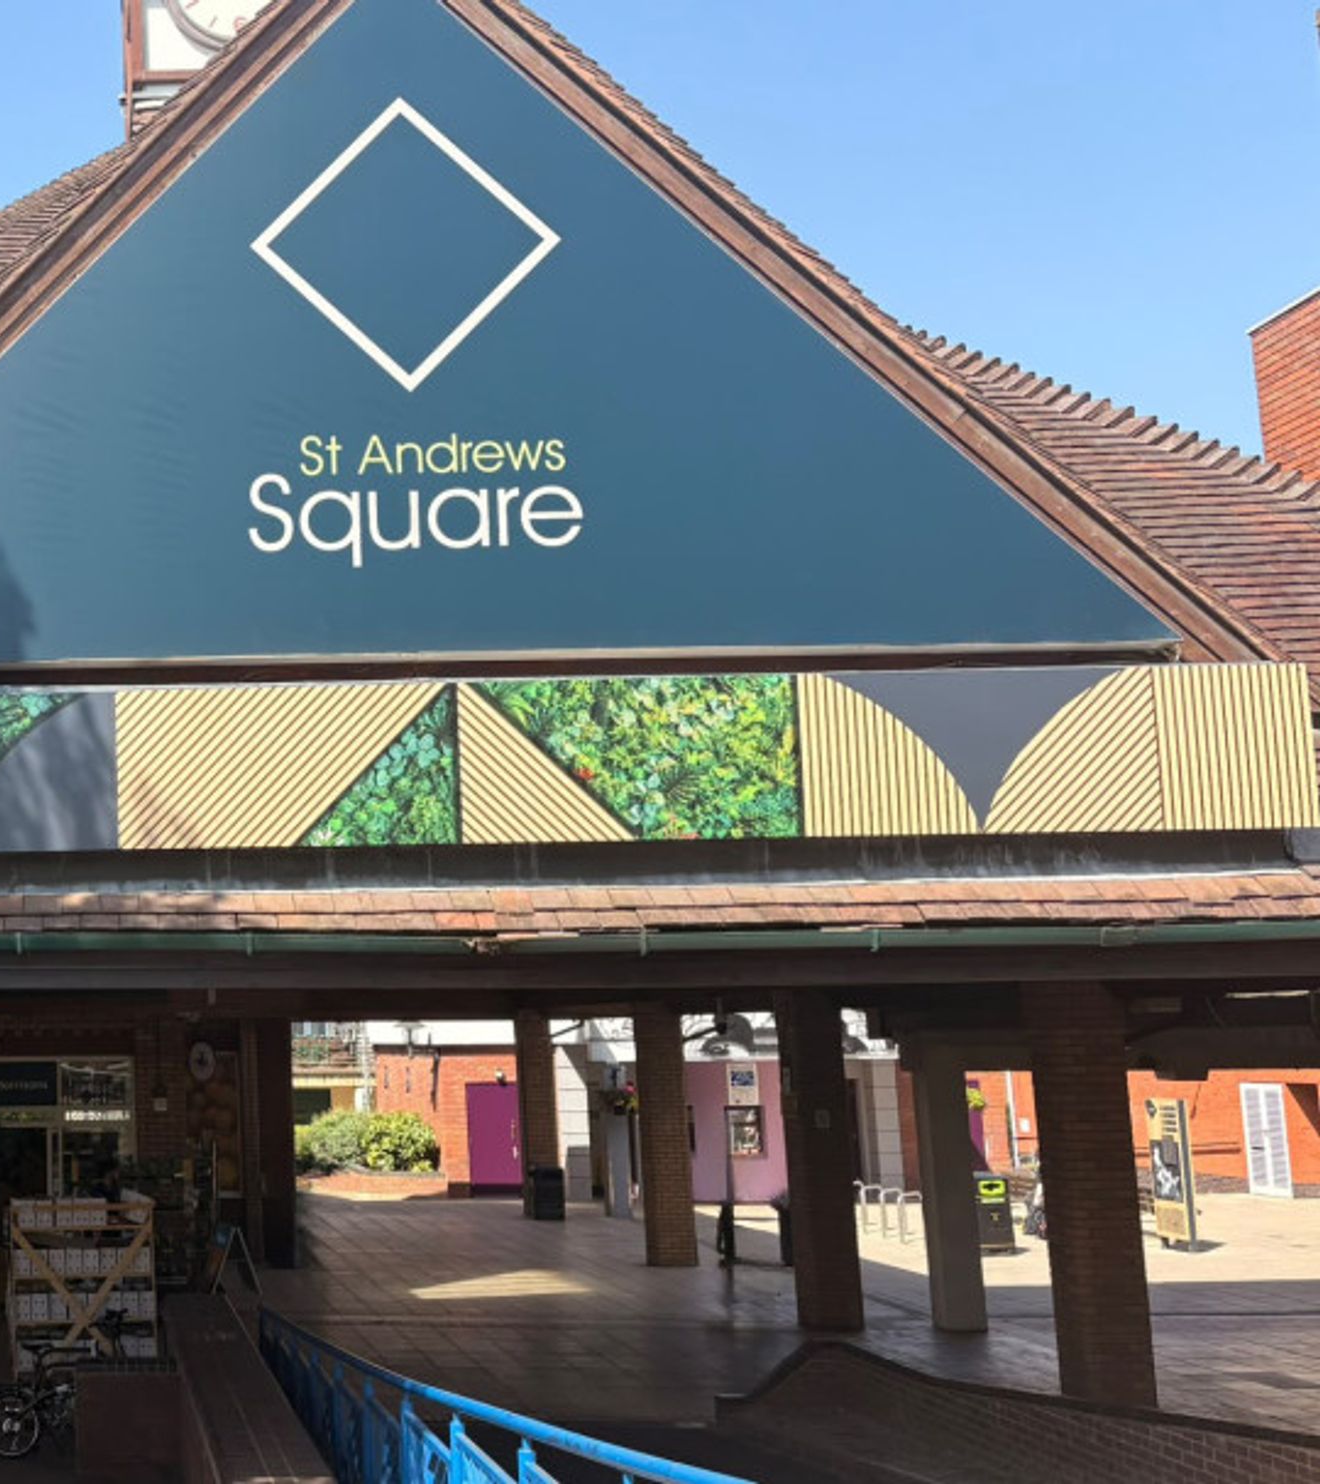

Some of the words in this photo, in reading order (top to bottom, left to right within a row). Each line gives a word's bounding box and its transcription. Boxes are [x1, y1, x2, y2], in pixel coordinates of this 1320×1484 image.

[299, 434, 343, 476] St
[357, 432, 567, 476] Andrews
[248, 473, 584, 569] Square
